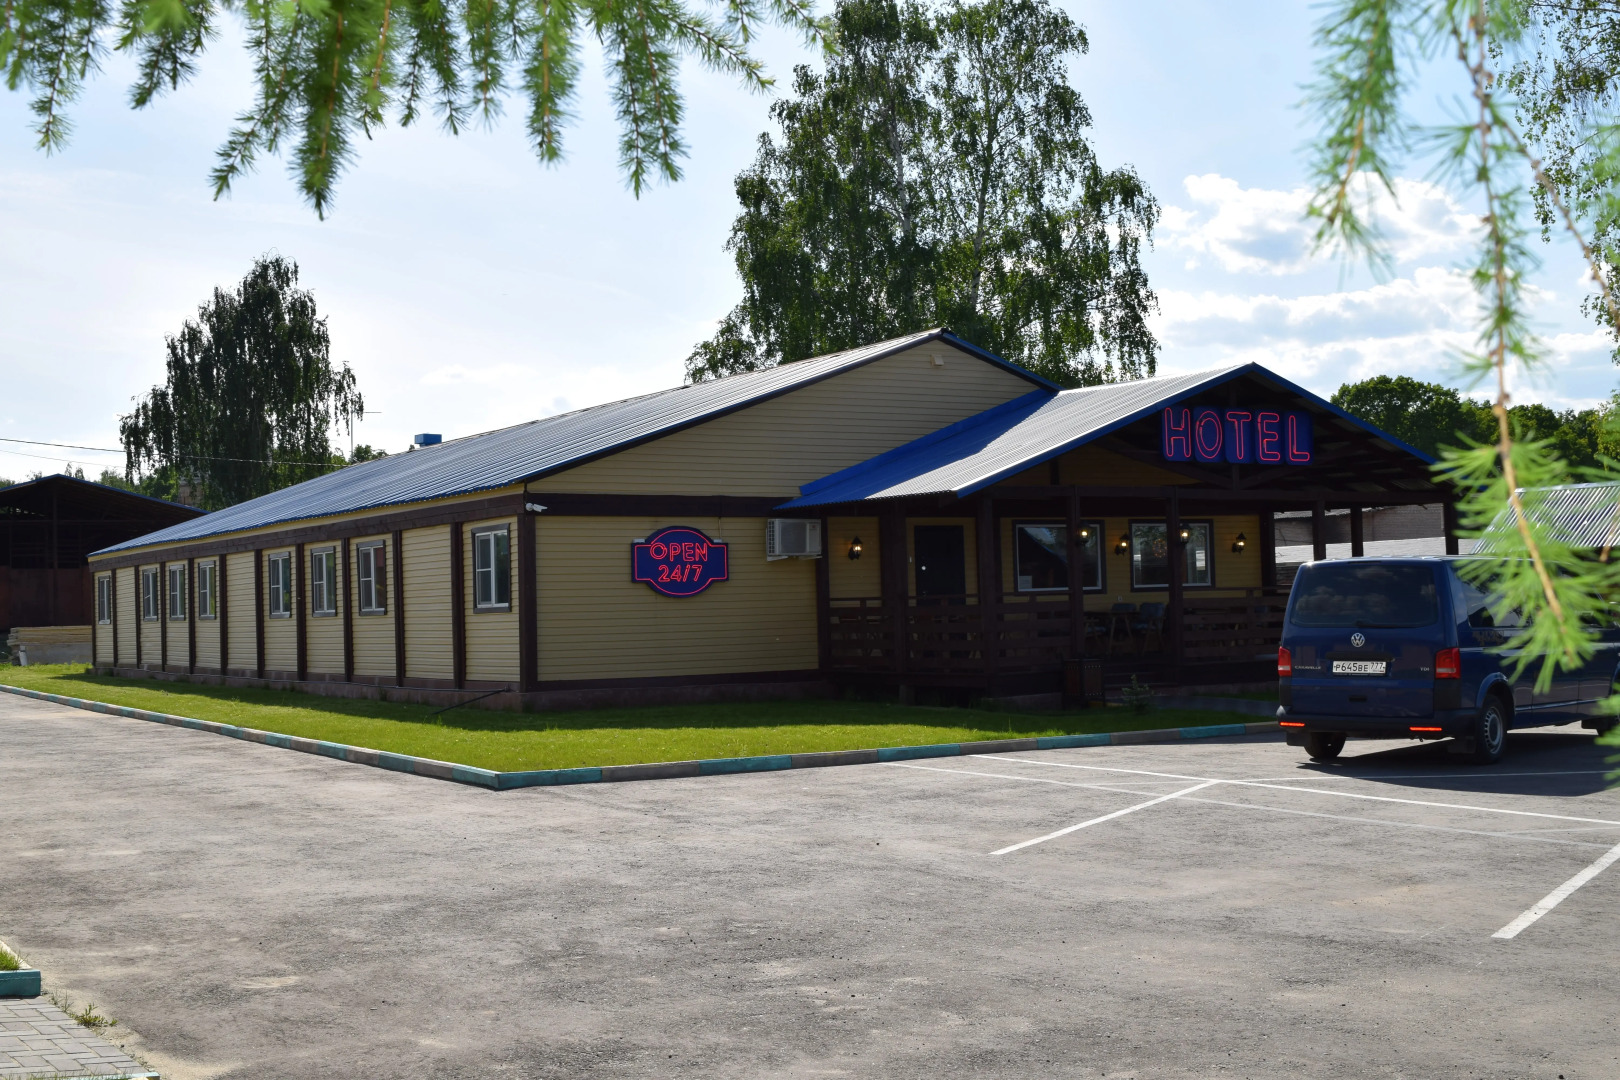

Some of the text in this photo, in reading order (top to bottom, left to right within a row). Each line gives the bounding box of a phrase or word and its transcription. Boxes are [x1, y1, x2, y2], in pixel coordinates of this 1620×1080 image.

[1164, 407, 1310, 461] HOTEL
[649, 542, 708, 562] OPEN
[658, 564, 702, 582] 24/7
